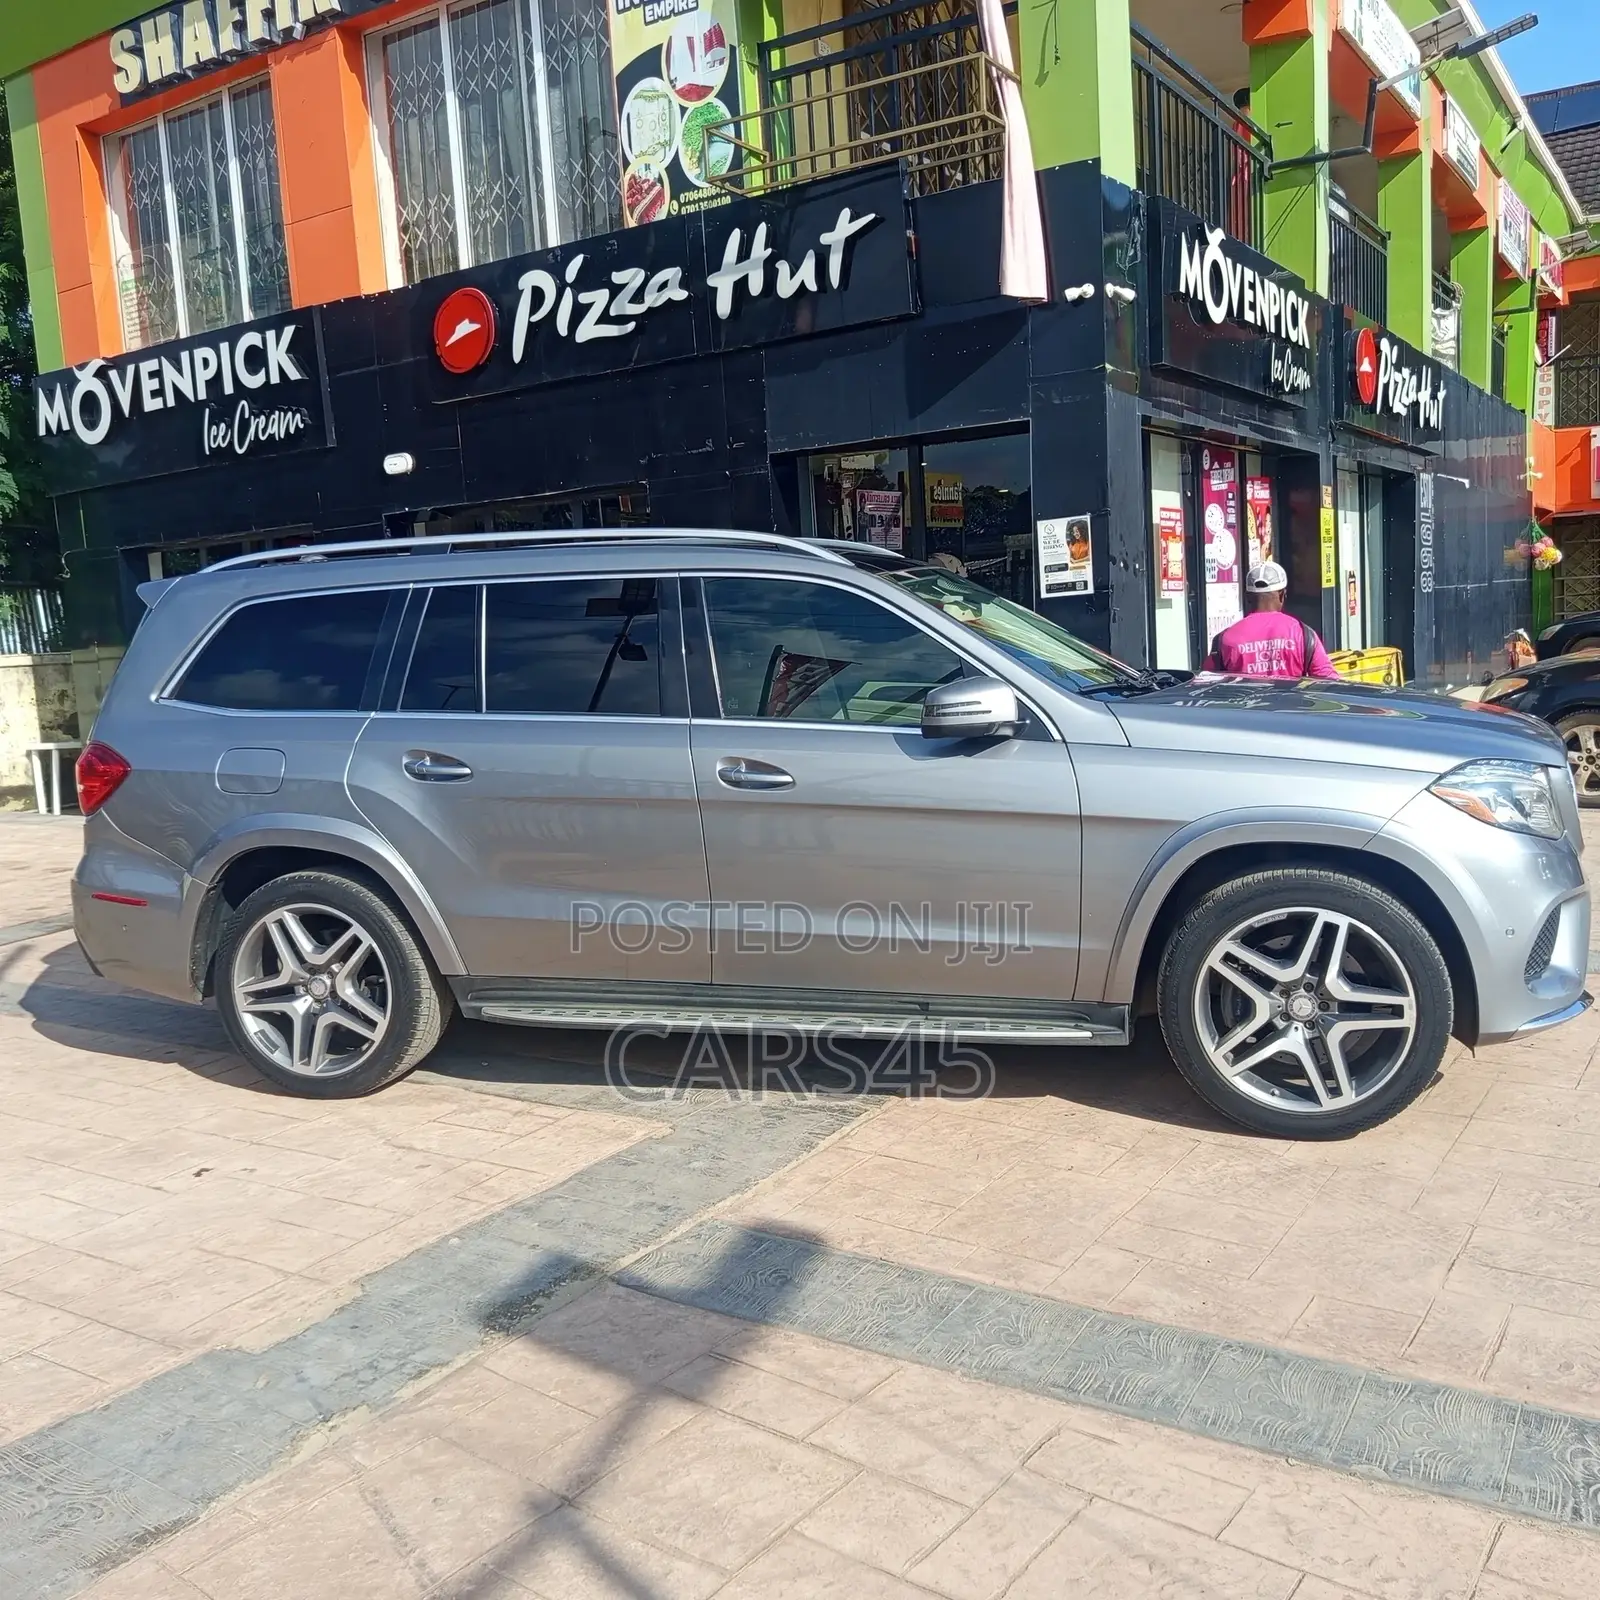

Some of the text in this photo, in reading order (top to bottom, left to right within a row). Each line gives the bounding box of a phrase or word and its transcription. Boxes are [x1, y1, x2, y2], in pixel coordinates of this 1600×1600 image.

[644, 0, 697, 23] EMPIRE
[512, 206, 877, 364] Pizza Hut
[1271, 342, 1311, 392] Ice Cream
[1376, 337, 1447, 431] Pizza Hut
[203, 400, 304, 456] Ice Cream
[1238, 638, 1296, 654] DELIVERING
